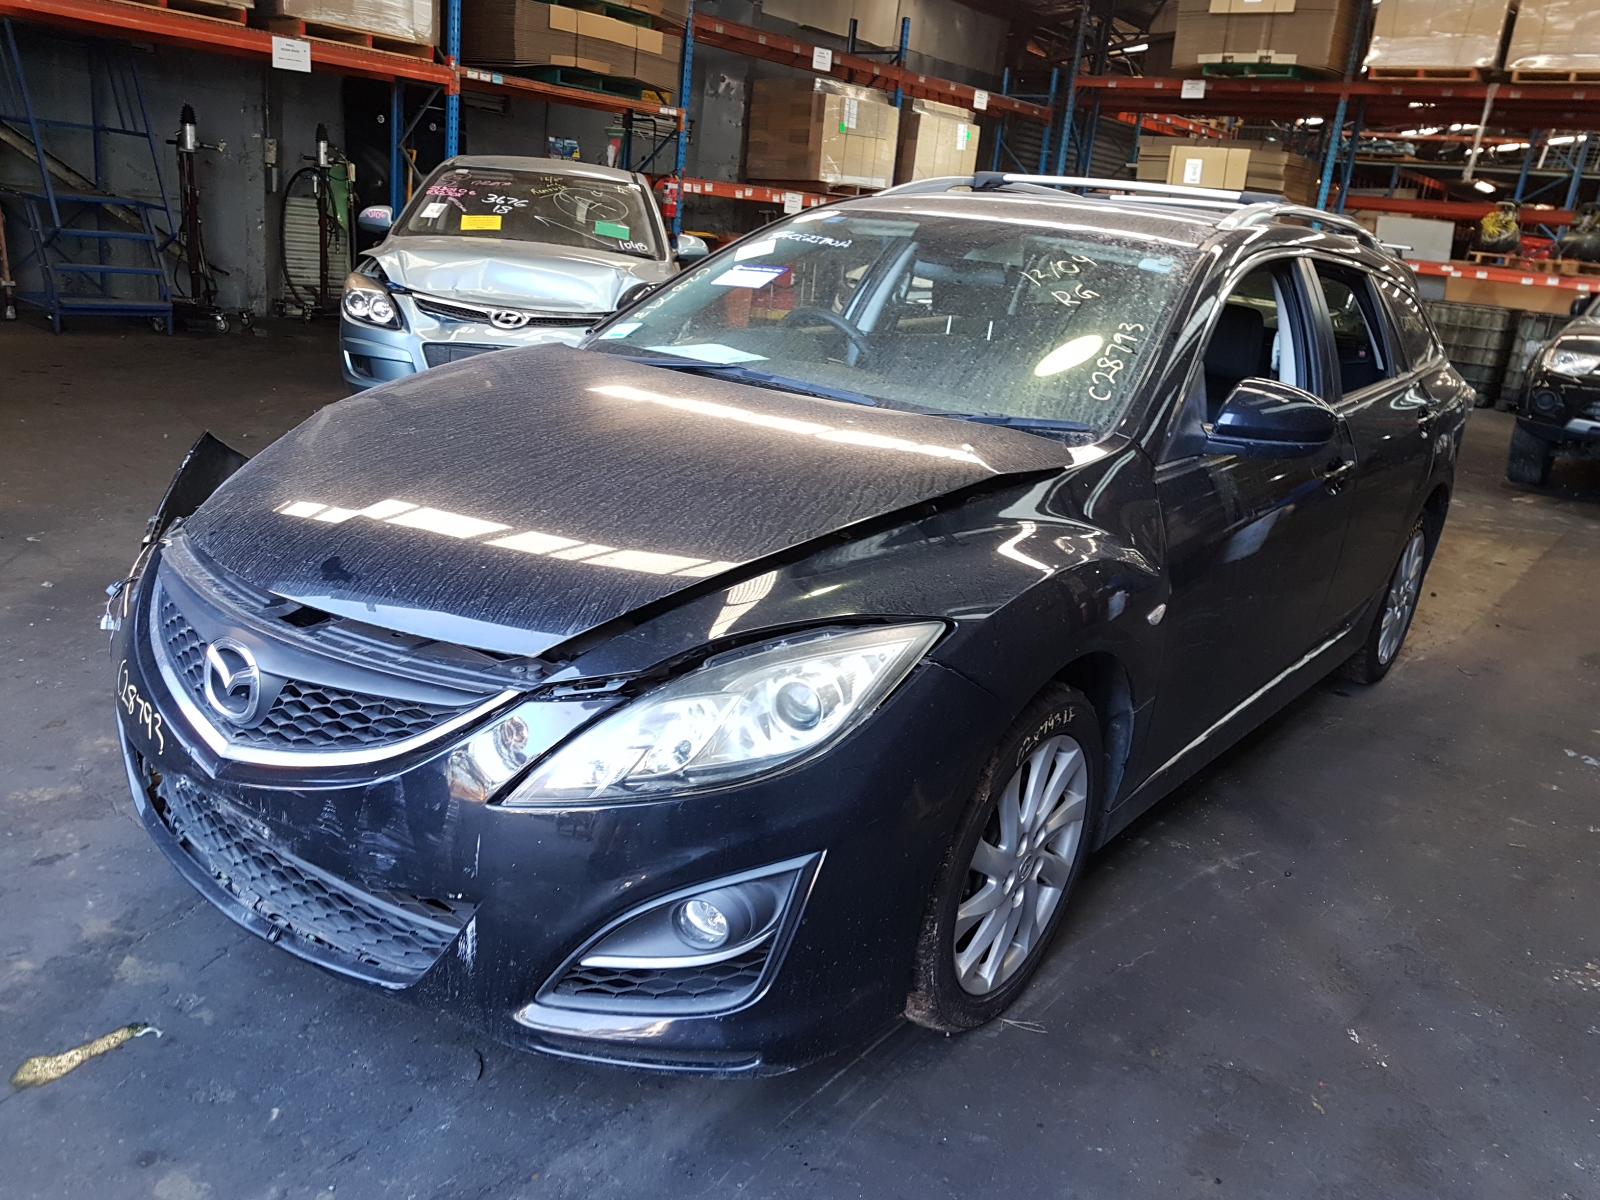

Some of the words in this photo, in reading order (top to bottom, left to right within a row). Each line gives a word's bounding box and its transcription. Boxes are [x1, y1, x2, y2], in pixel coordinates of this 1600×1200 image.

[492, 204, 513, 214] 18
[618, 240, 649, 252] 1048
[1051, 283, 1101, 307] RG
[1088, 322, 1145, 401] C28793
[117, 659, 164, 755] C28793
